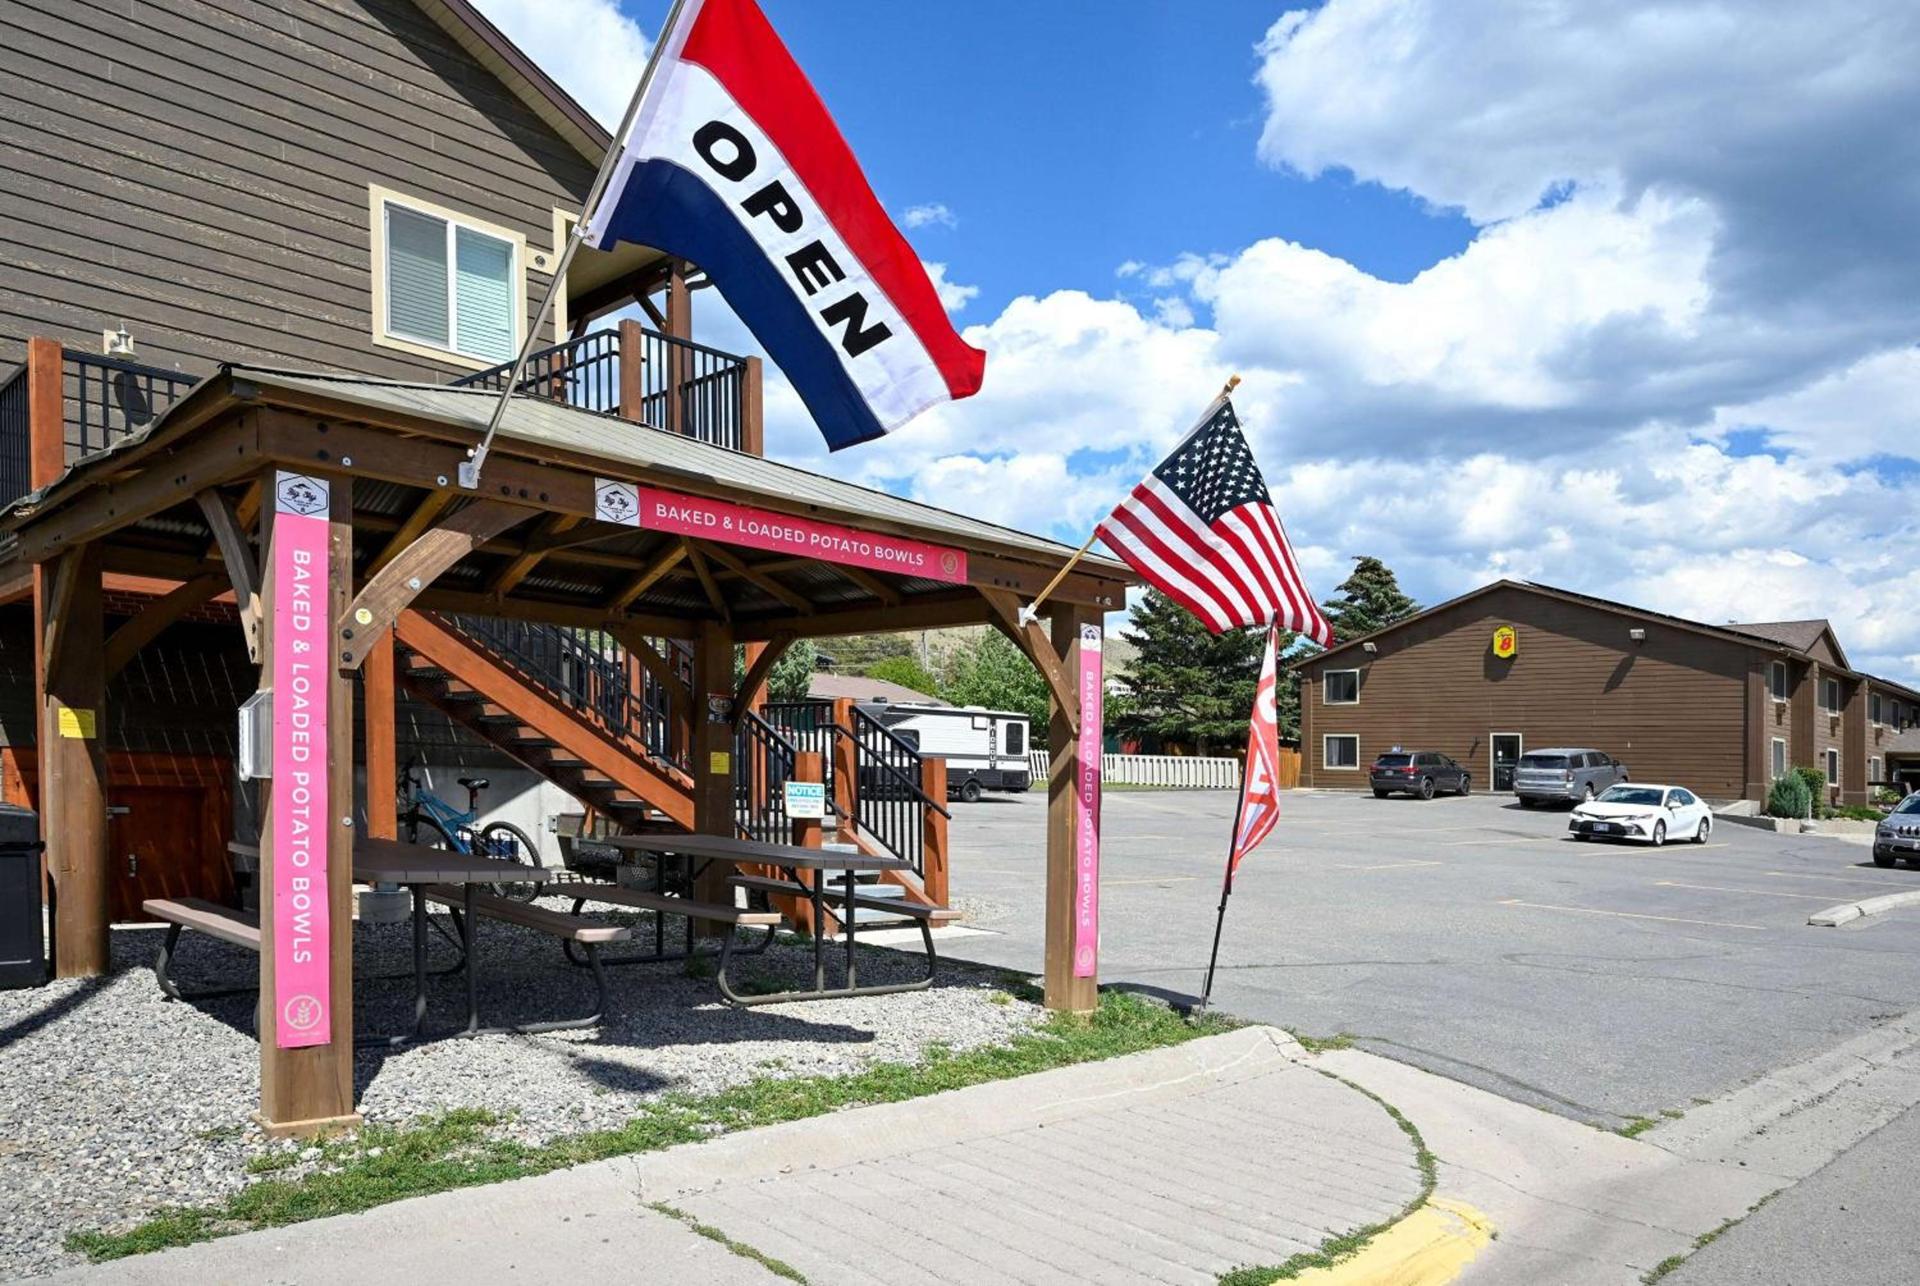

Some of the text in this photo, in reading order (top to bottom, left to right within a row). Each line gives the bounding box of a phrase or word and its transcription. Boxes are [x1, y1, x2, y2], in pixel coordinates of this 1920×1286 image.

[692, 120, 893, 359] OPEN
[656, 503, 924, 566] BAKED & LOADED POTATO BOWLS
[1085, 671, 1094, 722] BAKED
[291, 549, 312, 964] BAKED & LOADED POTATO BOWLS
[1084, 741, 1093, 803] LOADED
[788, 786, 823, 796] NOTICE
[1083, 808, 1093, 868] POTATO
[1081, 872, 1091, 928] BOWLS
